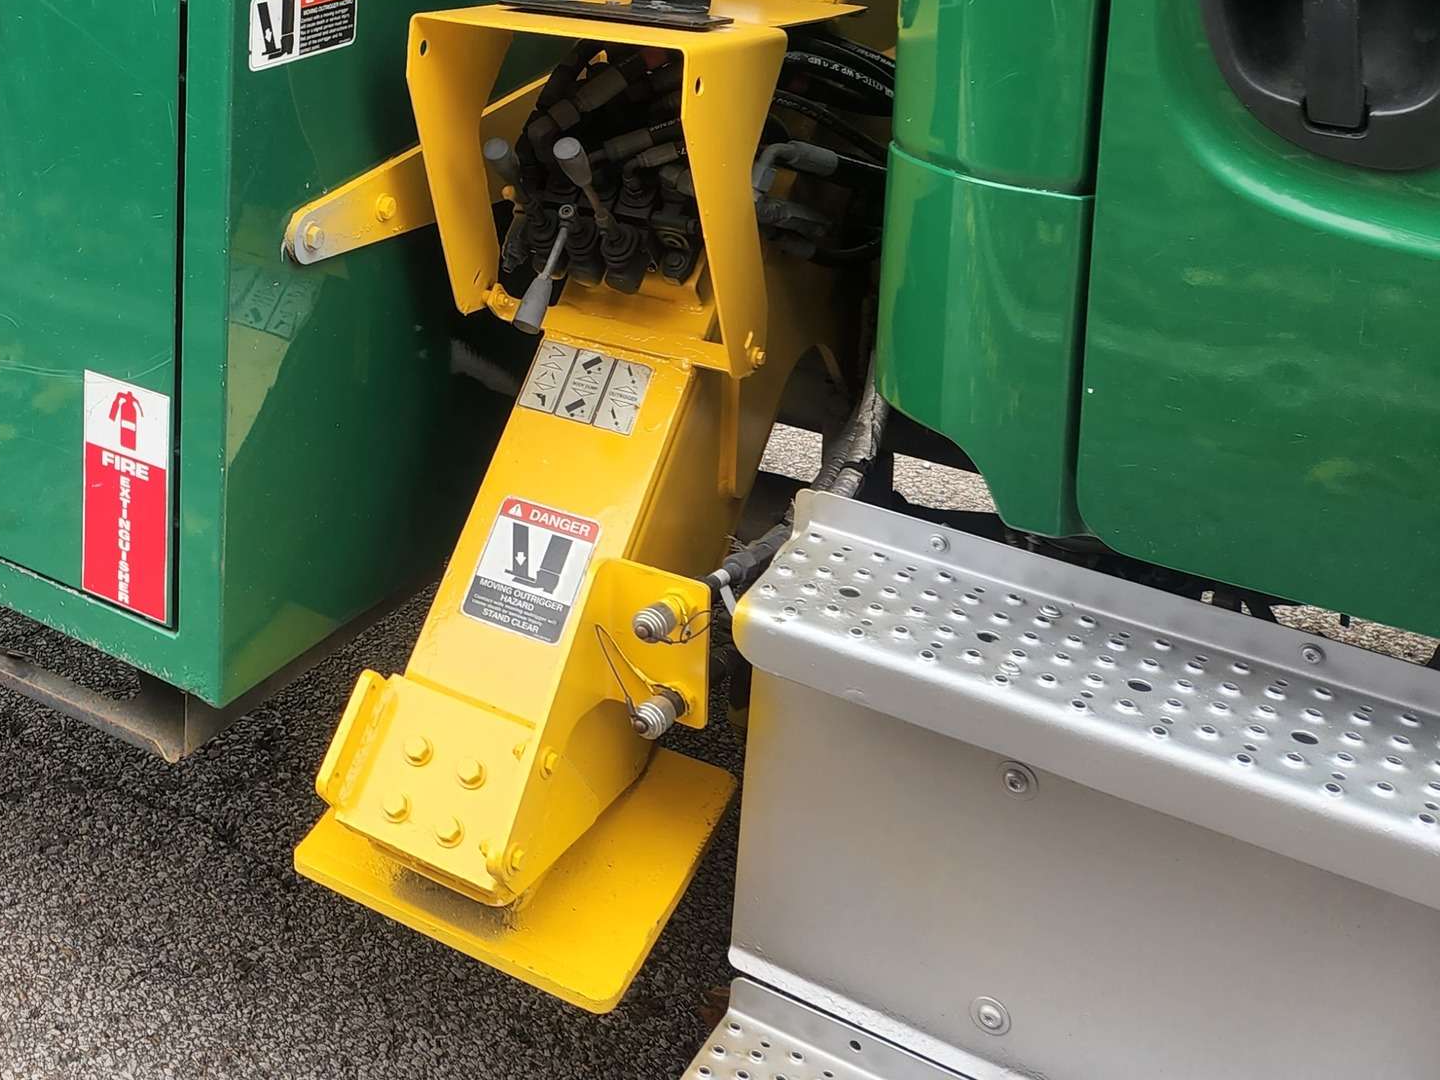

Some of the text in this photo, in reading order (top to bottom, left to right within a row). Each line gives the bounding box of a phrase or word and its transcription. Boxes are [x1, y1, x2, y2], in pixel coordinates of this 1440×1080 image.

[101, 450, 150, 482] FIRE
[529, 509, 592, 537] DANGER
[117, 476, 132, 605] EXTINGUISHER
[479, 578, 564, 612] MOVING OUTRIGGER
[500, 595, 535, 611] HAZARD
[482, 608, 540, 634] STAND CLEAR
